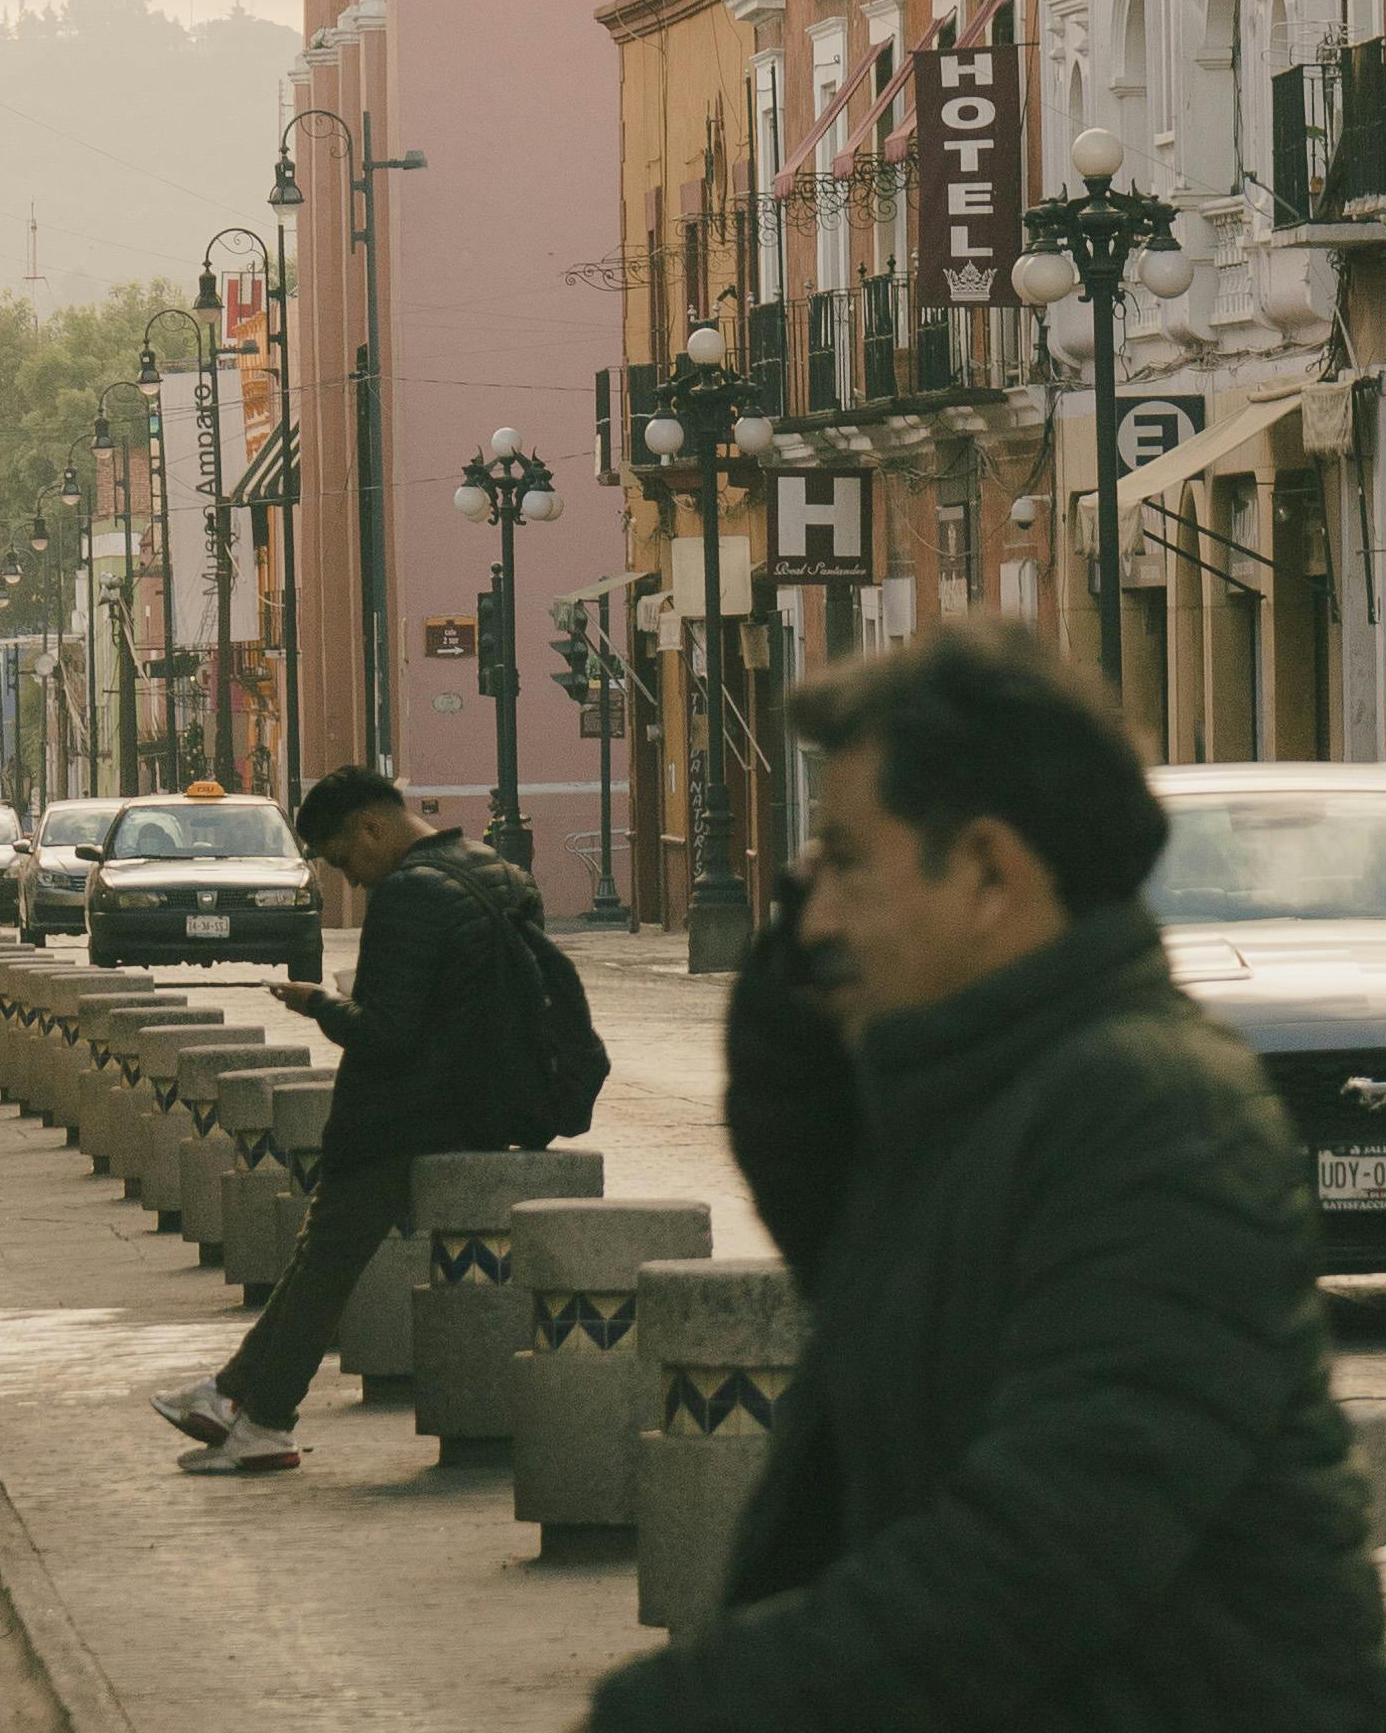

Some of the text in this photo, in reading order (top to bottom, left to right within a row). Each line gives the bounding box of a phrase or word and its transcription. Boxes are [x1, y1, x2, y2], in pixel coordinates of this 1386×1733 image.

[940, 53, 996, 257] HOTEL
[193, 382, 219, 497] Amparo
[778, 477, 861, 557] H
